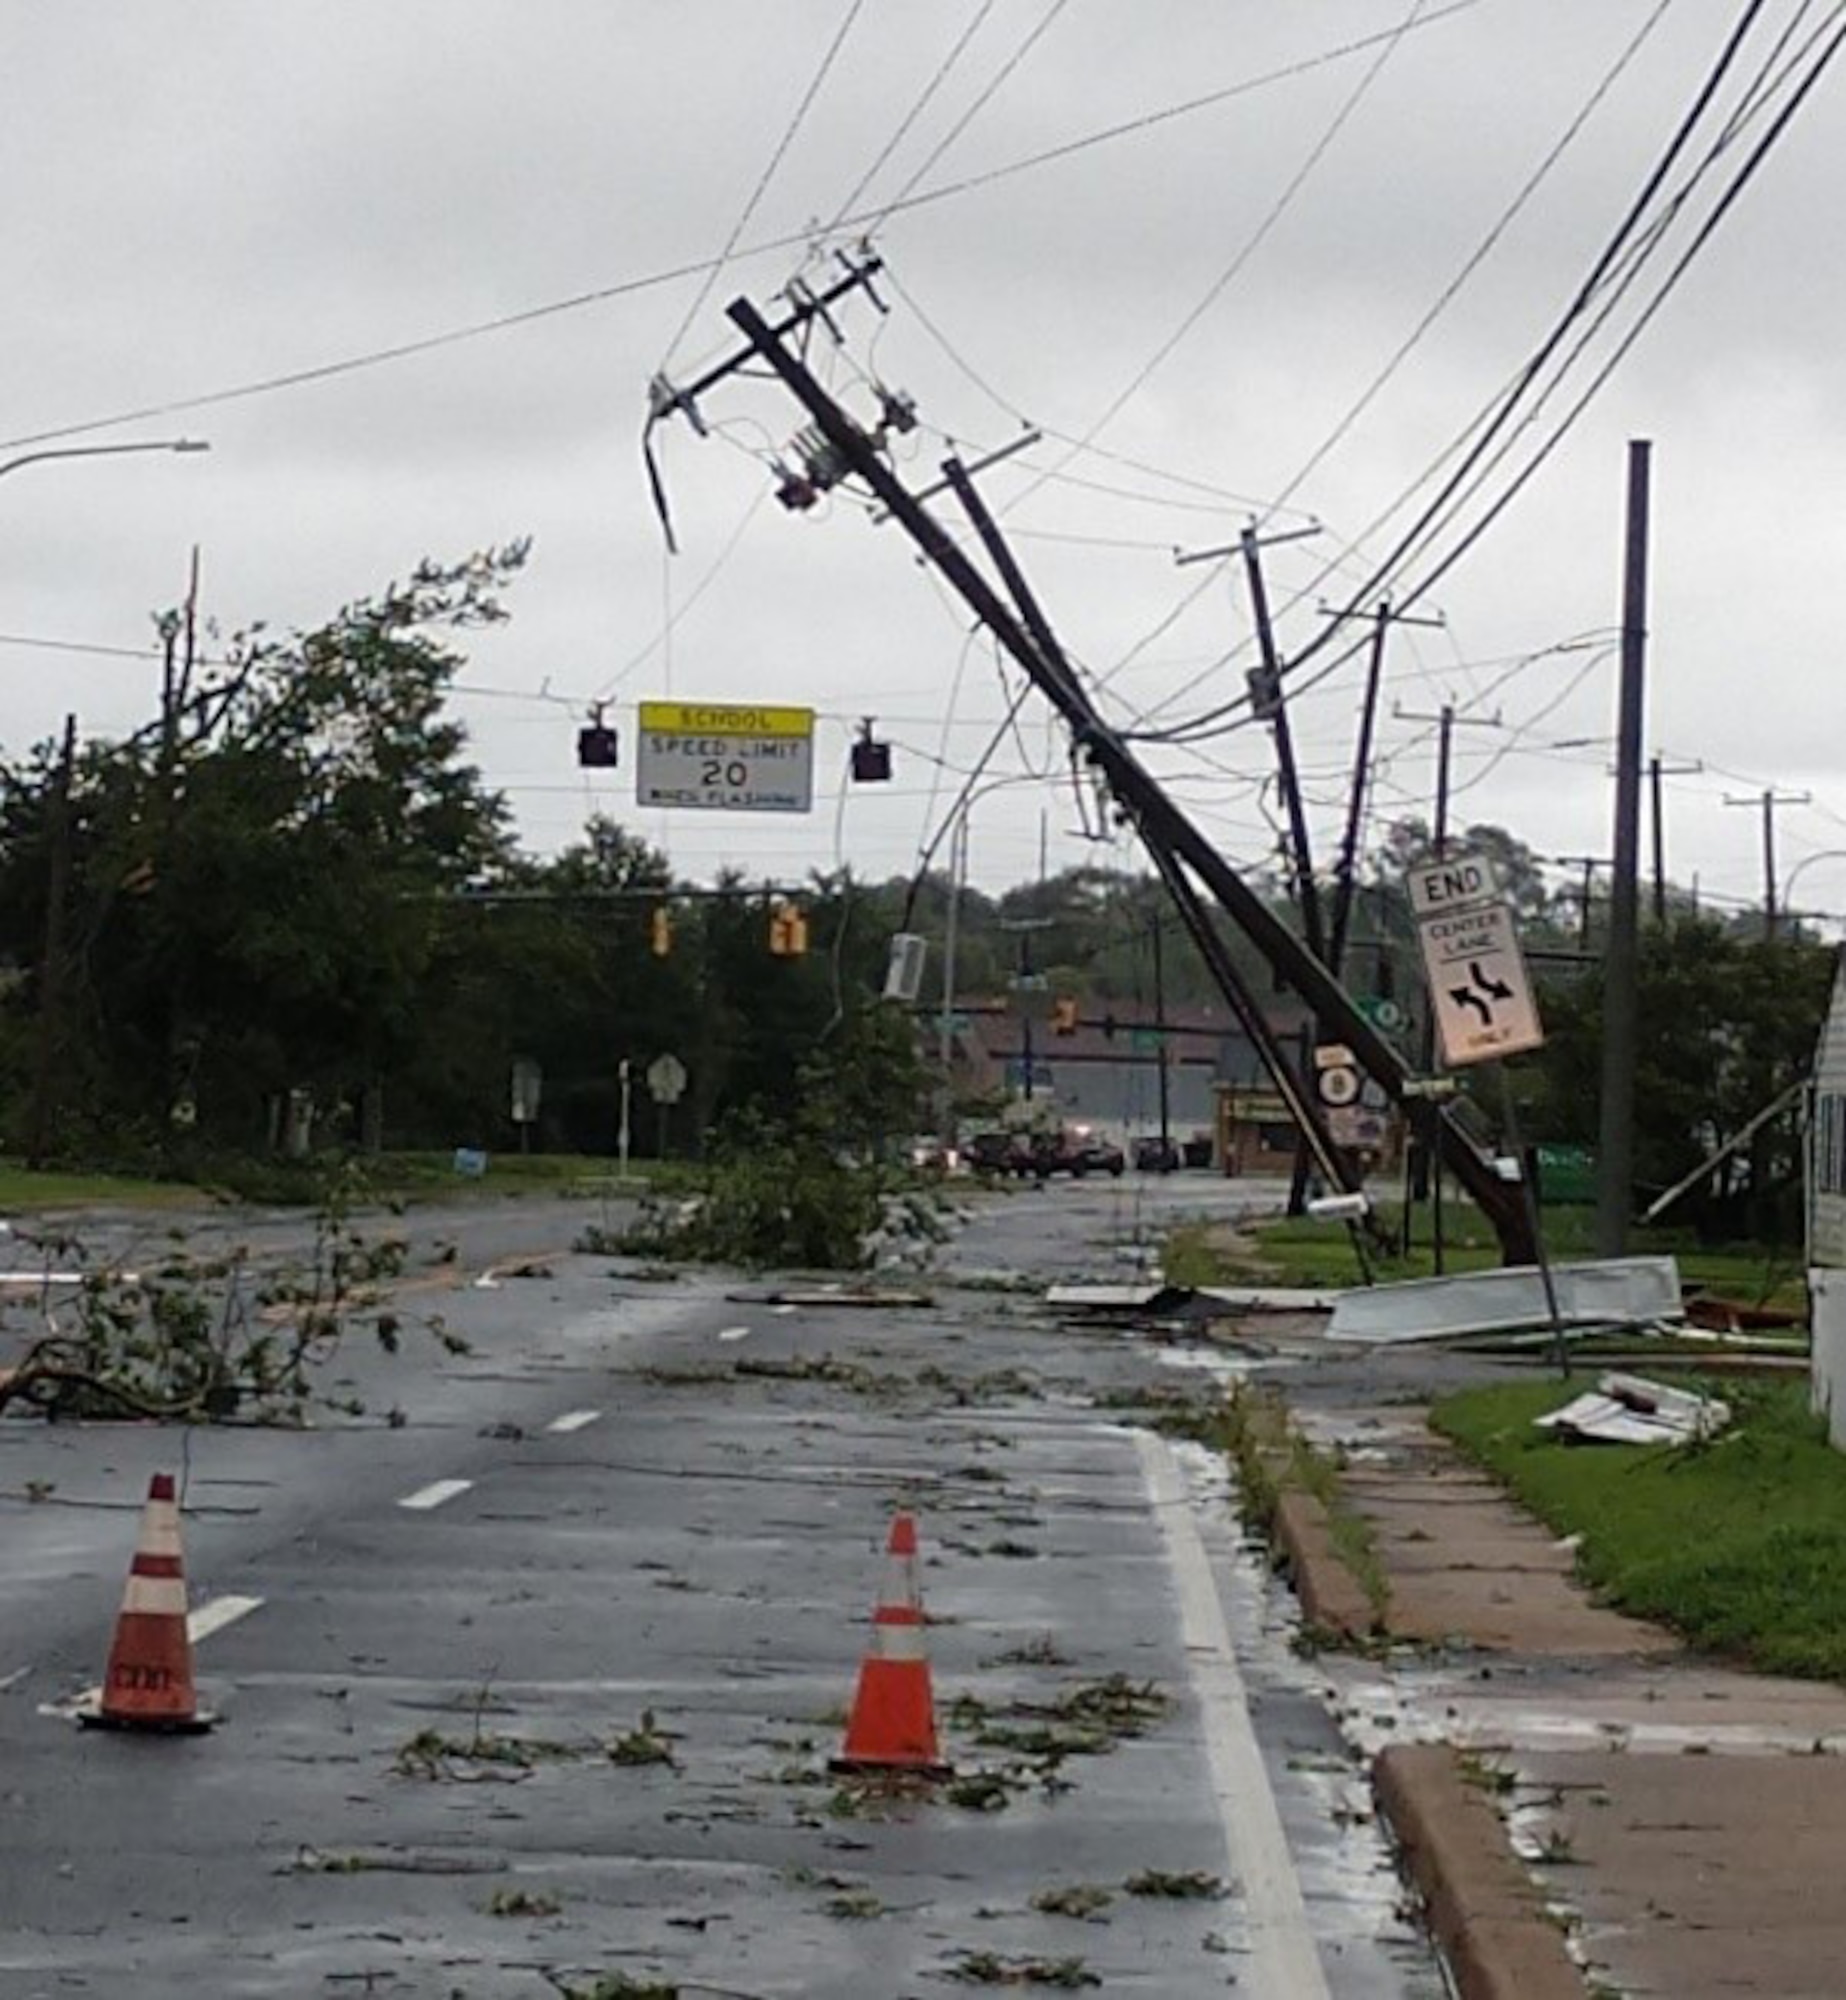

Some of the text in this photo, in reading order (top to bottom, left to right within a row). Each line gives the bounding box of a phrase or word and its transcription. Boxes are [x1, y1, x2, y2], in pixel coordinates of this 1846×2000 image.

[680, 710, 772, 729] SCHOOL
[651, 737, 800, 760] SPEED LIMIT
[701, 760, 748, 787] 20
[1424, 865, 1483, 902] END
[1430, 912, 1500, 941] CENTER
[1443, 933, 1495, 955] LANE
